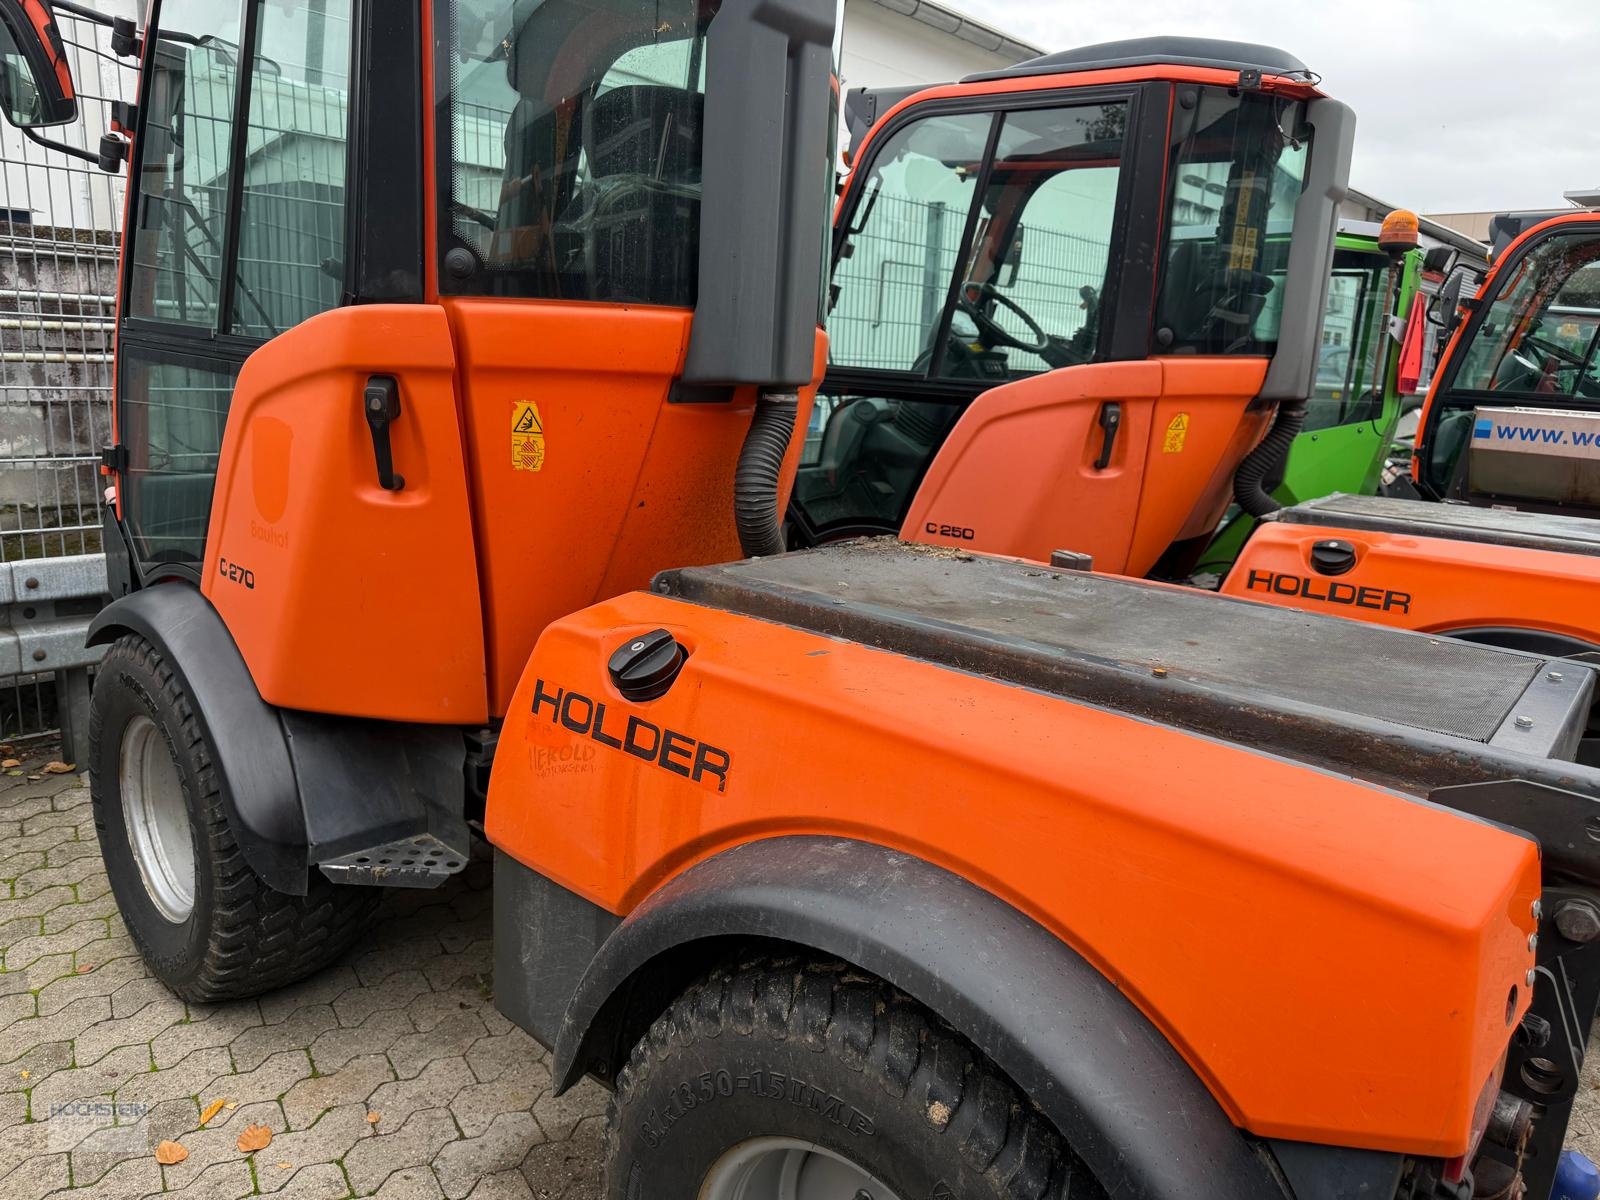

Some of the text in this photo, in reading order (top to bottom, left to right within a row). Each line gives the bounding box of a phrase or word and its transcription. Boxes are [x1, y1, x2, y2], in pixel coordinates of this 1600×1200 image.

[926, 522, 974, 540] C 250
[220, 558, 254, 589] C 270
[1247, 569, 1412, 615] HOLDER
[531, 679, 730, 792] HOLDER
